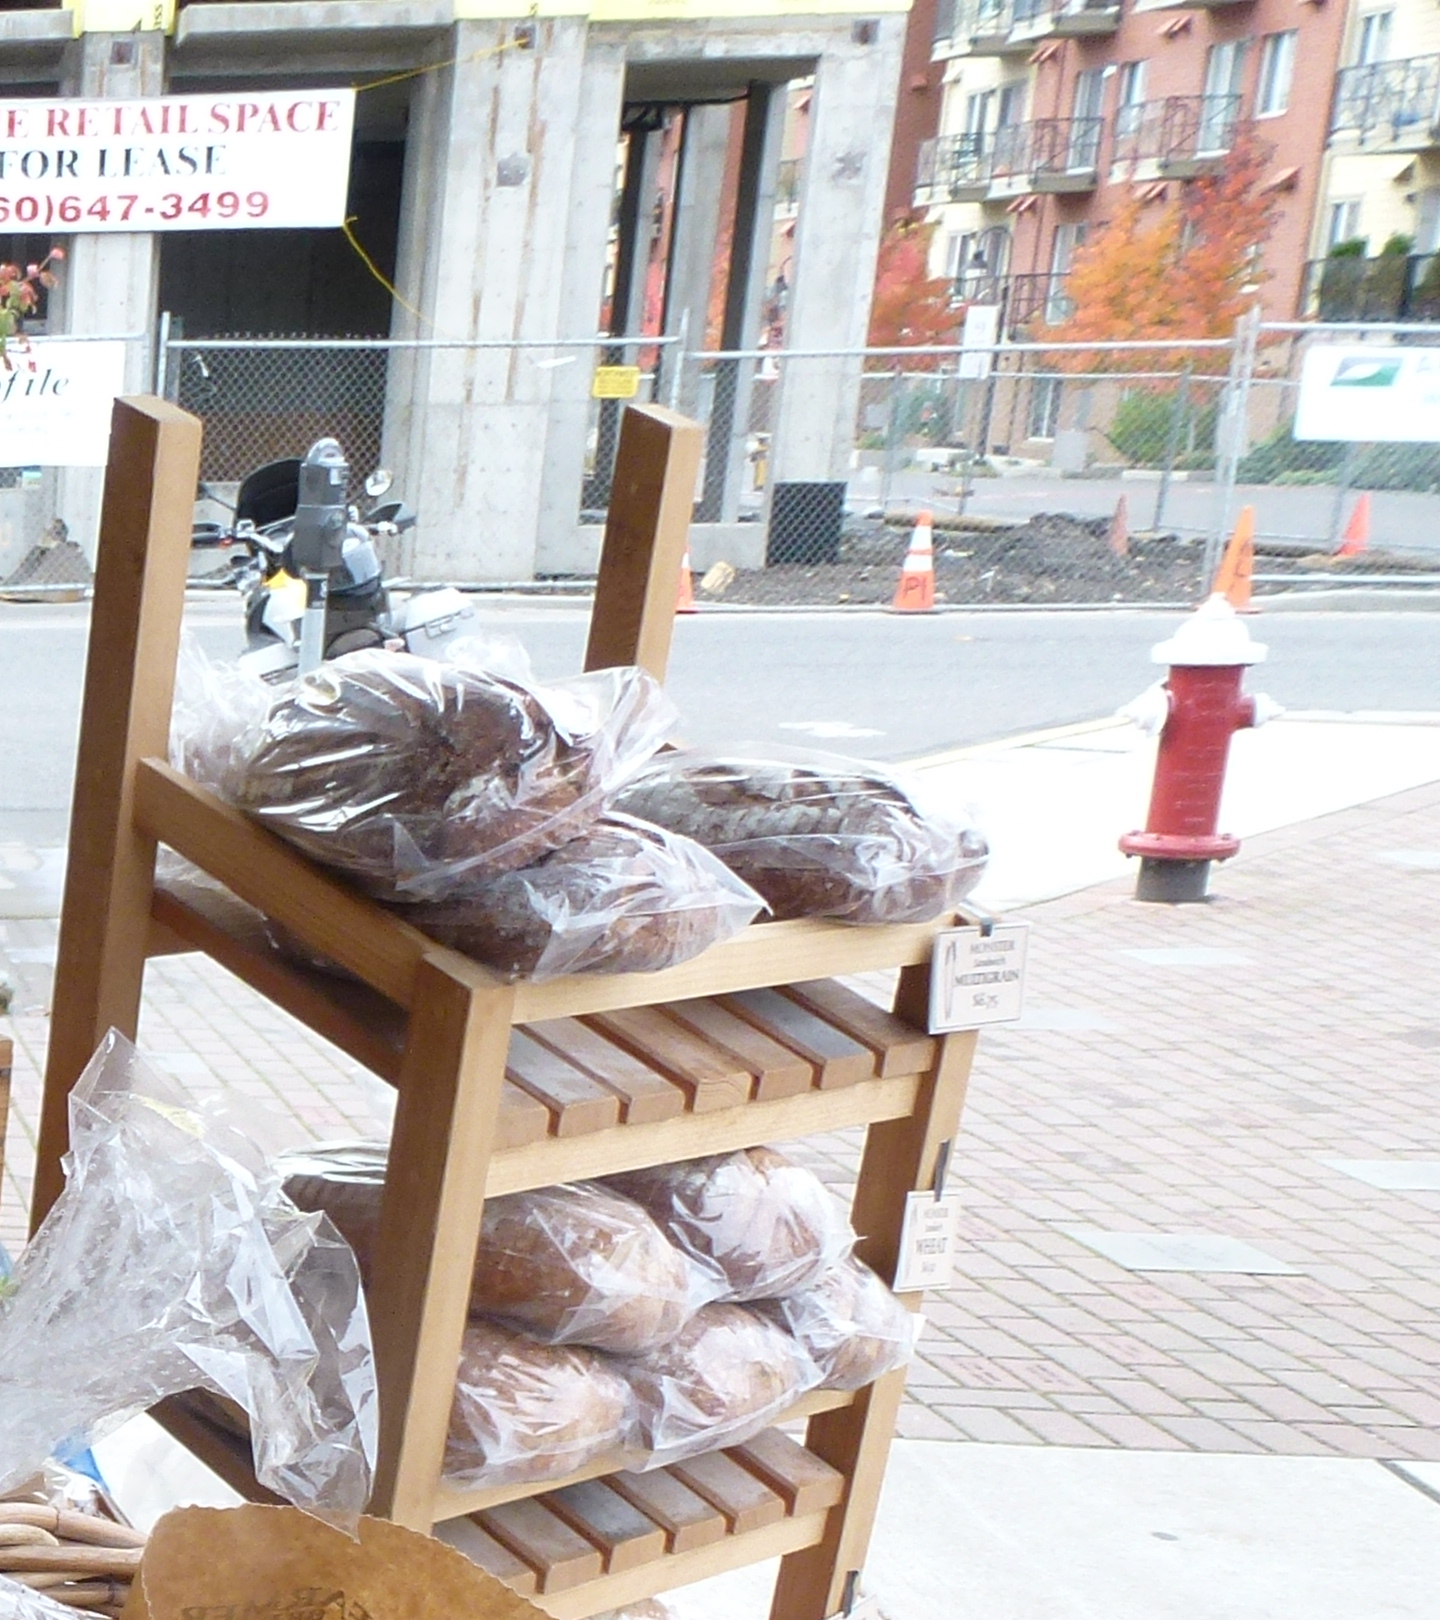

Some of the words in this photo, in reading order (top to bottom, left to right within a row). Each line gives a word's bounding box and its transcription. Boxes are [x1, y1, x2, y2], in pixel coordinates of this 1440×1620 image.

[45, 104, 199, 138] RETAIL
[209, 100, 342, 135] SPACE
[97, 144, 229, 178] LEASE
